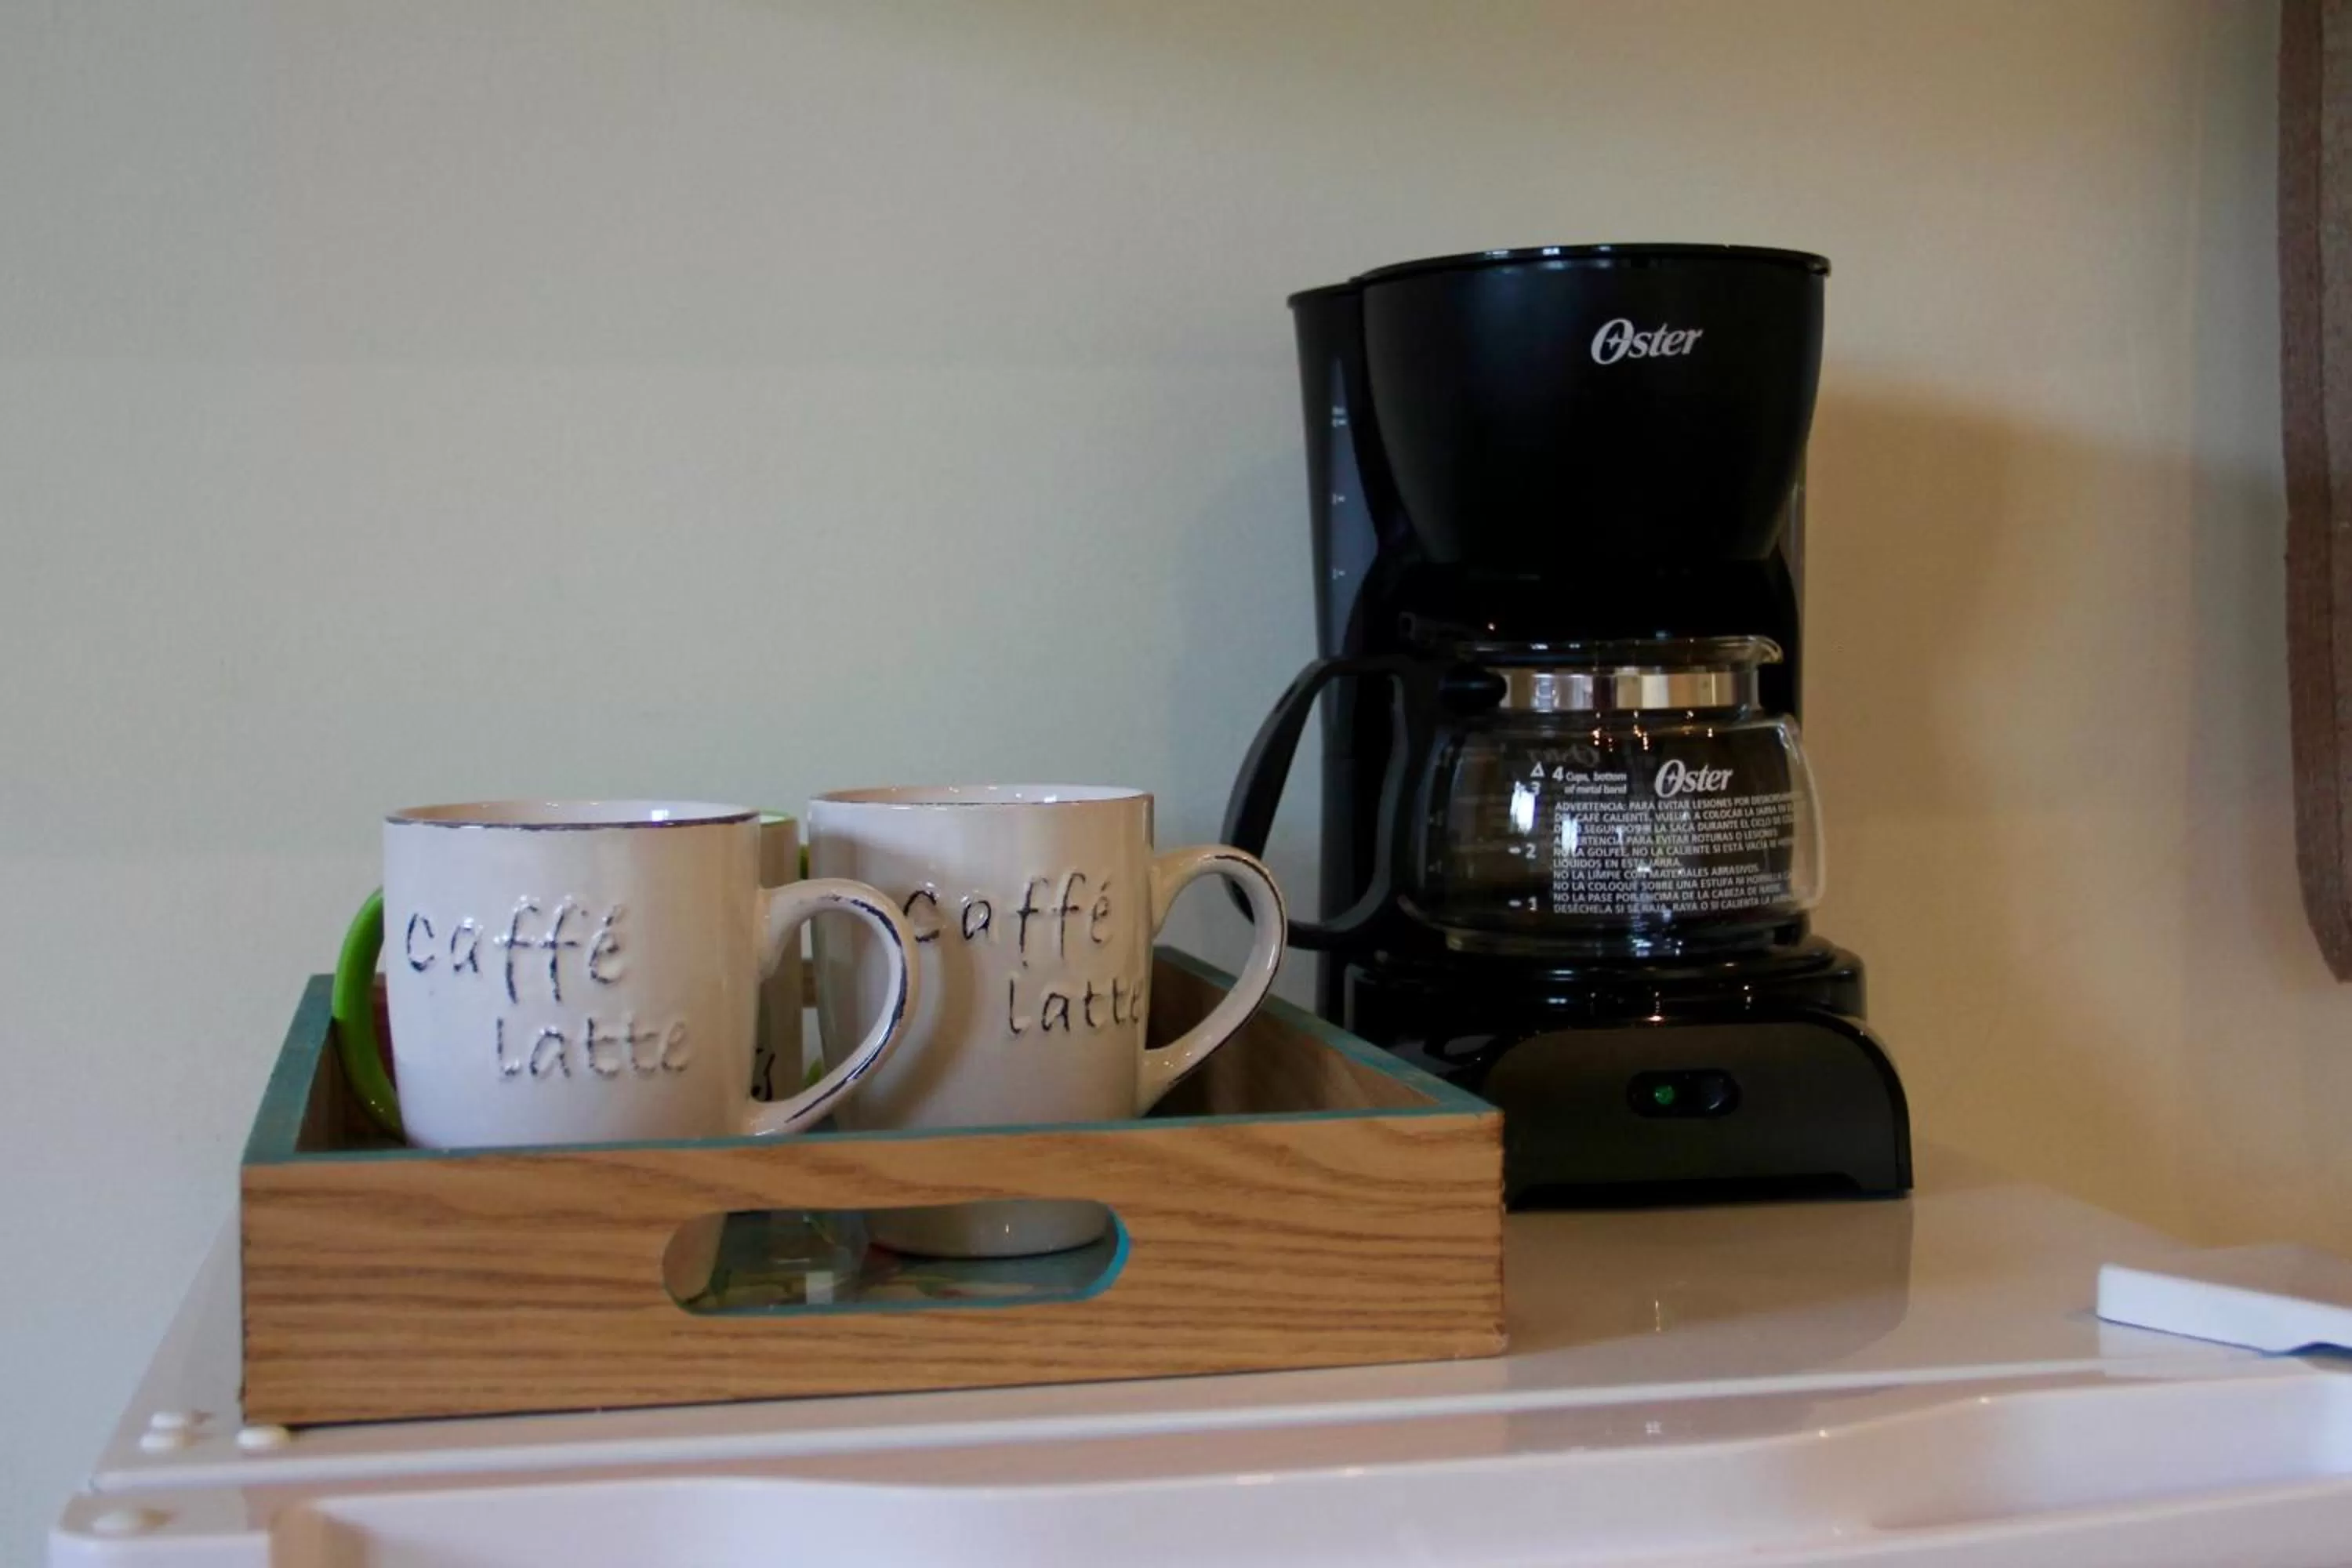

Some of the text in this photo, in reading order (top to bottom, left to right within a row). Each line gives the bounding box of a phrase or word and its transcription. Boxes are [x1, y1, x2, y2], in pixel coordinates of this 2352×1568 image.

[1591, 318, 1704, 365] Oster
[1552, 766, 1564, 782] 4
[1655, 759, 1733, 798] Oster
[1628, 800, 1655, 811] PARA
[1658, 800, 1690, 811] EVITAR
[1693, 797, 1733, 809] LESIONES
[1693, 810, 1701, 820] A
[1702, 808, 1743, 820] COLOCAR
[1653, 823, 1667, 833] LA
[1670, 822, 1696, 833] SACA
[1697, 819, 1738, 831] DURANTE
[1655, 833, 1689, 844] EVITAR
[1691, 832, 1733, 844] ROTURAS
[1735, 831, 1742, 840] O
[1526, 842, 1536, 859] 2
[1632, 846, 1649, 856] NO
[1651, 846, 1664, 855] LA
[1666, 844, 1711, 855] CALIENTE
[1712, 843, 1721, 853] SI
[1605, 858, 1619, 868] EN
[1554, 870, 1570, 880] NO
[1573, 870, 1585, 880] LA
[1554, 881, 1570, 891] NO
[1572, 881, 1585, 891] LA
[1588, 880, 1638, 891] COLOQUE
[1641, 880, 1674, 891] SOBRE
[1676, 878, 1697, 889] UNA
[1700, 876, 1733, 887] ESTUFA
[1554, 892, 1570, 902] NO
[1572, 892, 1585, 902] LA
[1588, 892, 1613, 902] PASE
[1616, 892, 1637, 902] POR
[1682, 890, 1695, 901] DE
[1697, 889, 1710, 899] LA
[1711, 886, 1745, 898] CABEZA
[1528, 896, 1537, 912] 1
[1672, 901, 1698, 911] RAYA
[1700, 901, 1708, 910] O
